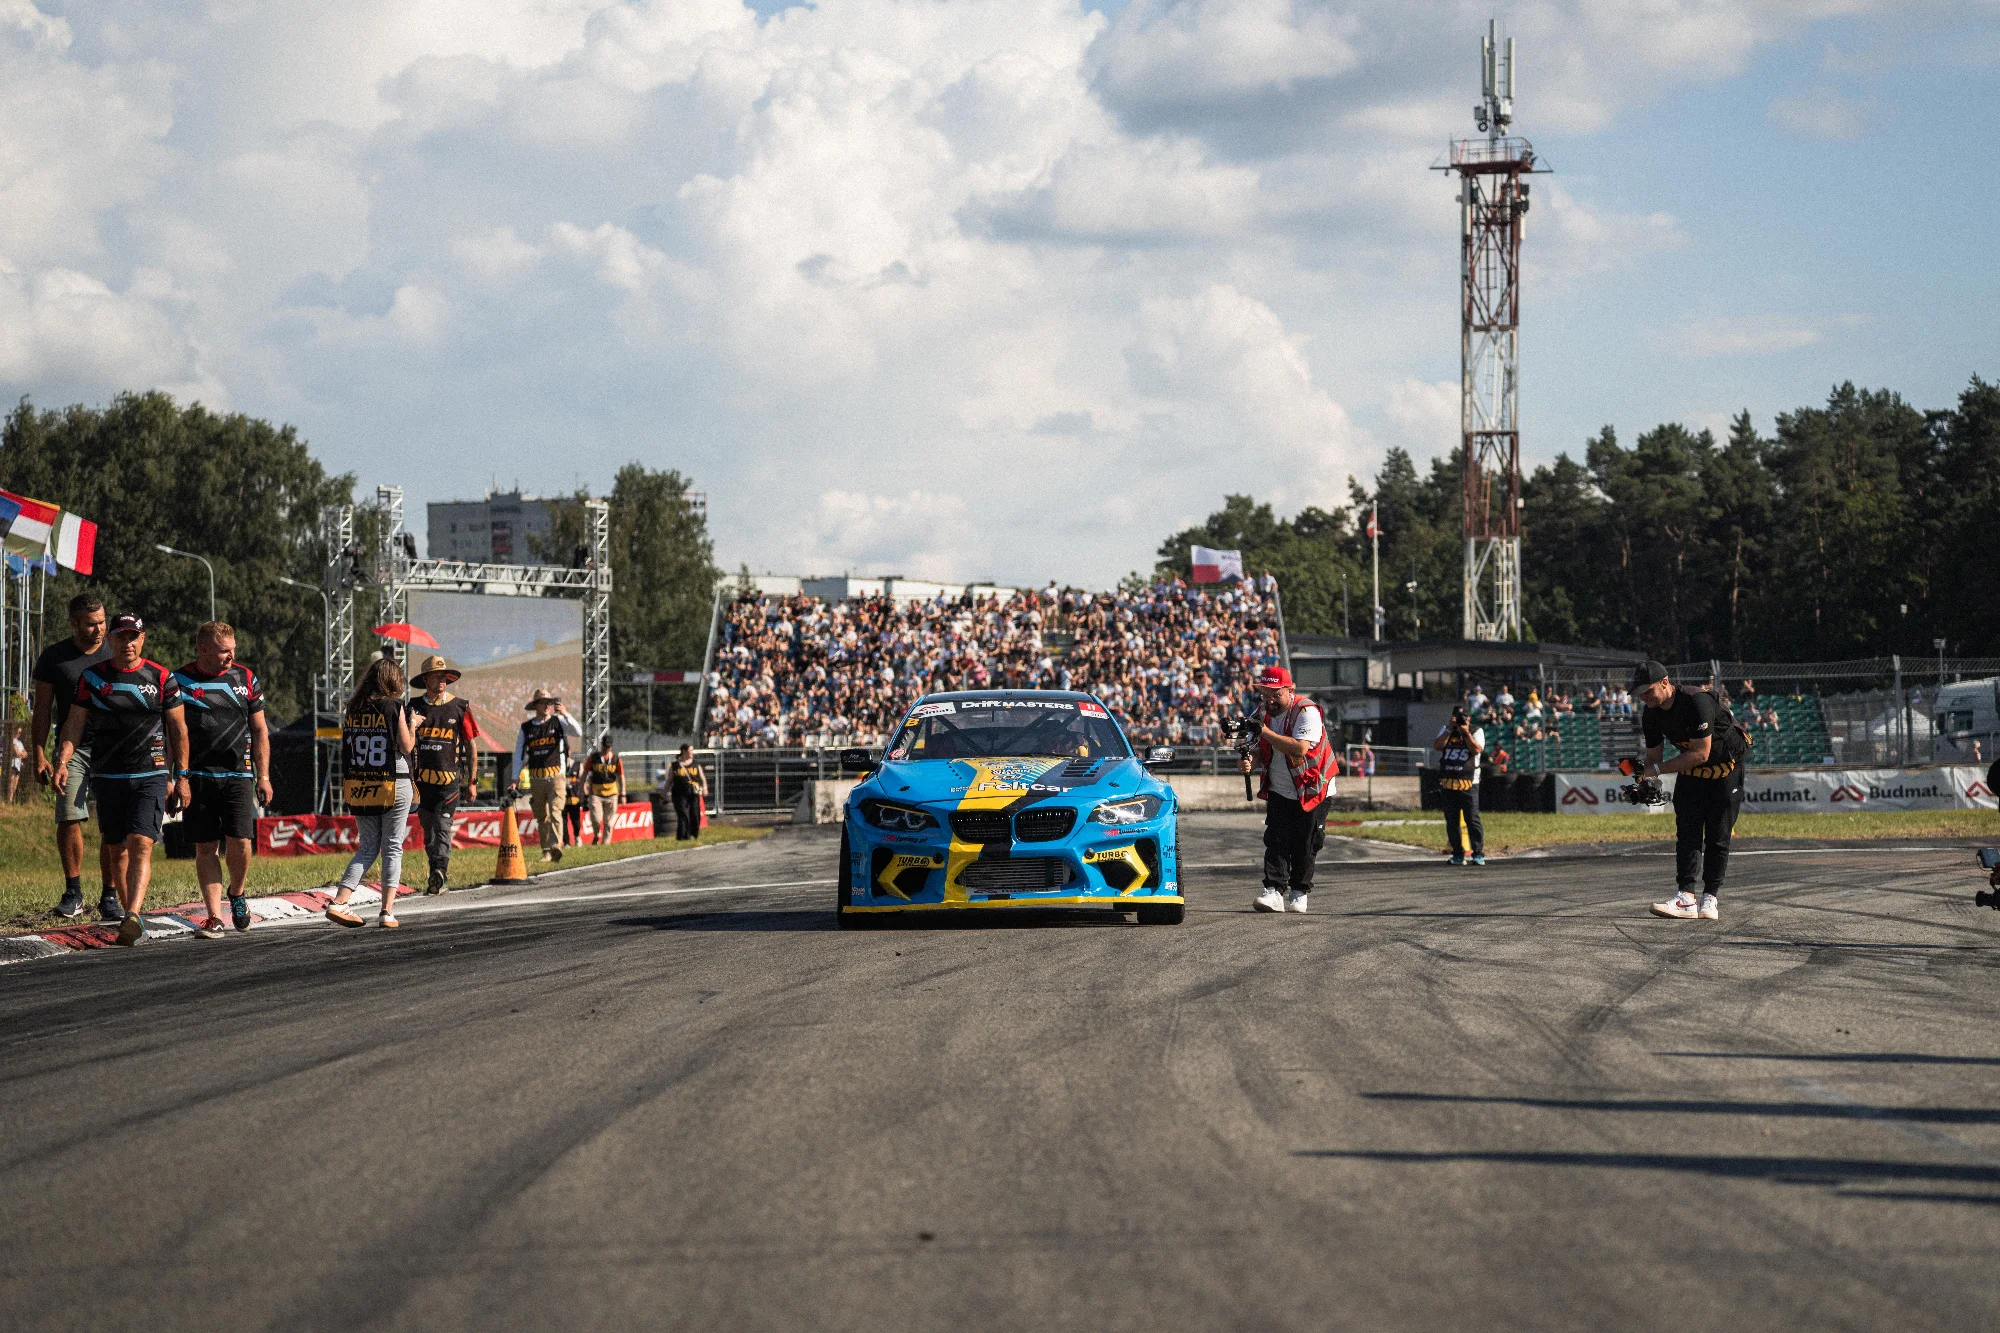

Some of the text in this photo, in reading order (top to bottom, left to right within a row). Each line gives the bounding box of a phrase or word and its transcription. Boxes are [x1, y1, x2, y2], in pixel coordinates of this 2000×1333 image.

[961, 700, 1075, 710] Drift MASTERS
[345, 713, 388, 729] MEDIA
[346, 735, 388, 768] 198
[978, 781, 1074, 793] Feltcar
[1869, 784, 1945, 799] Budmat.
